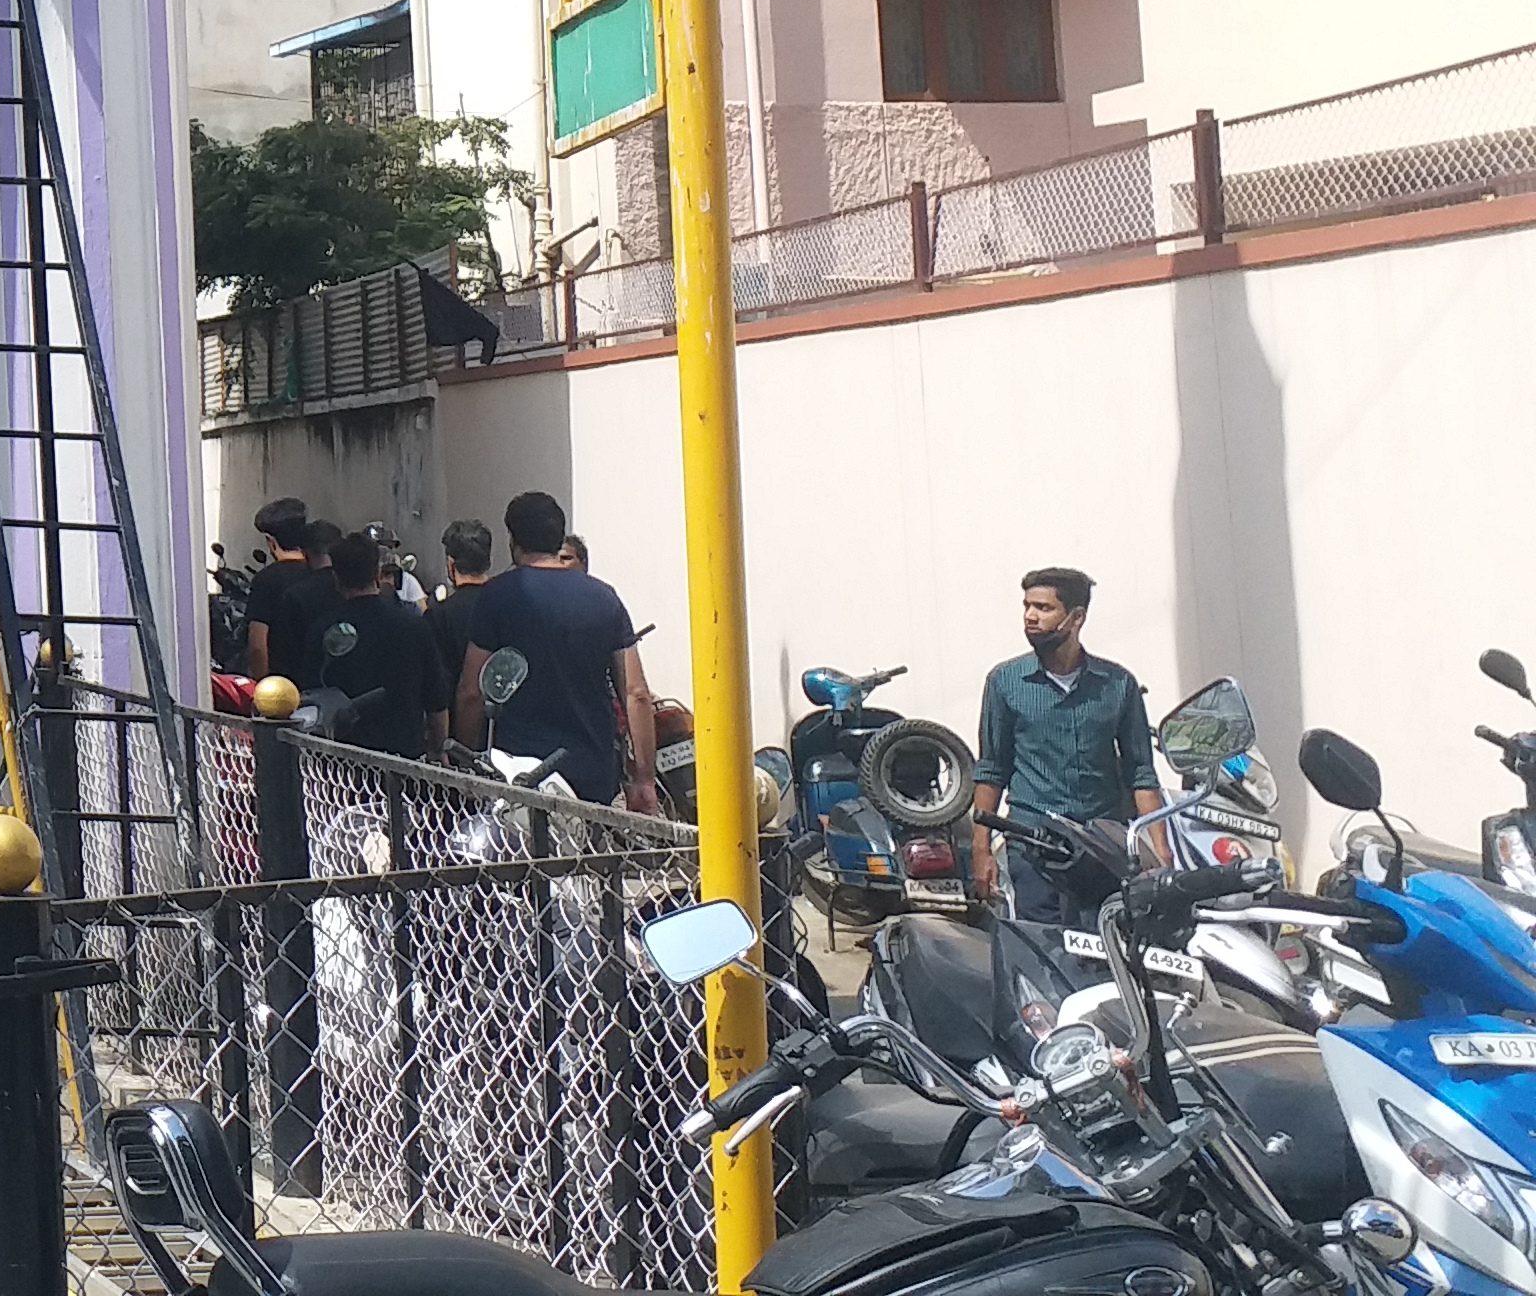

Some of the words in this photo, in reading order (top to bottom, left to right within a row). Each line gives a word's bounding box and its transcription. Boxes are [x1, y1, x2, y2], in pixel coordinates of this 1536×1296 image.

[1069, 935, 1093, 952] KA
[1447, 1040, 1485, 1057] KA
[1499, 1040, 1522, 1058] 03
